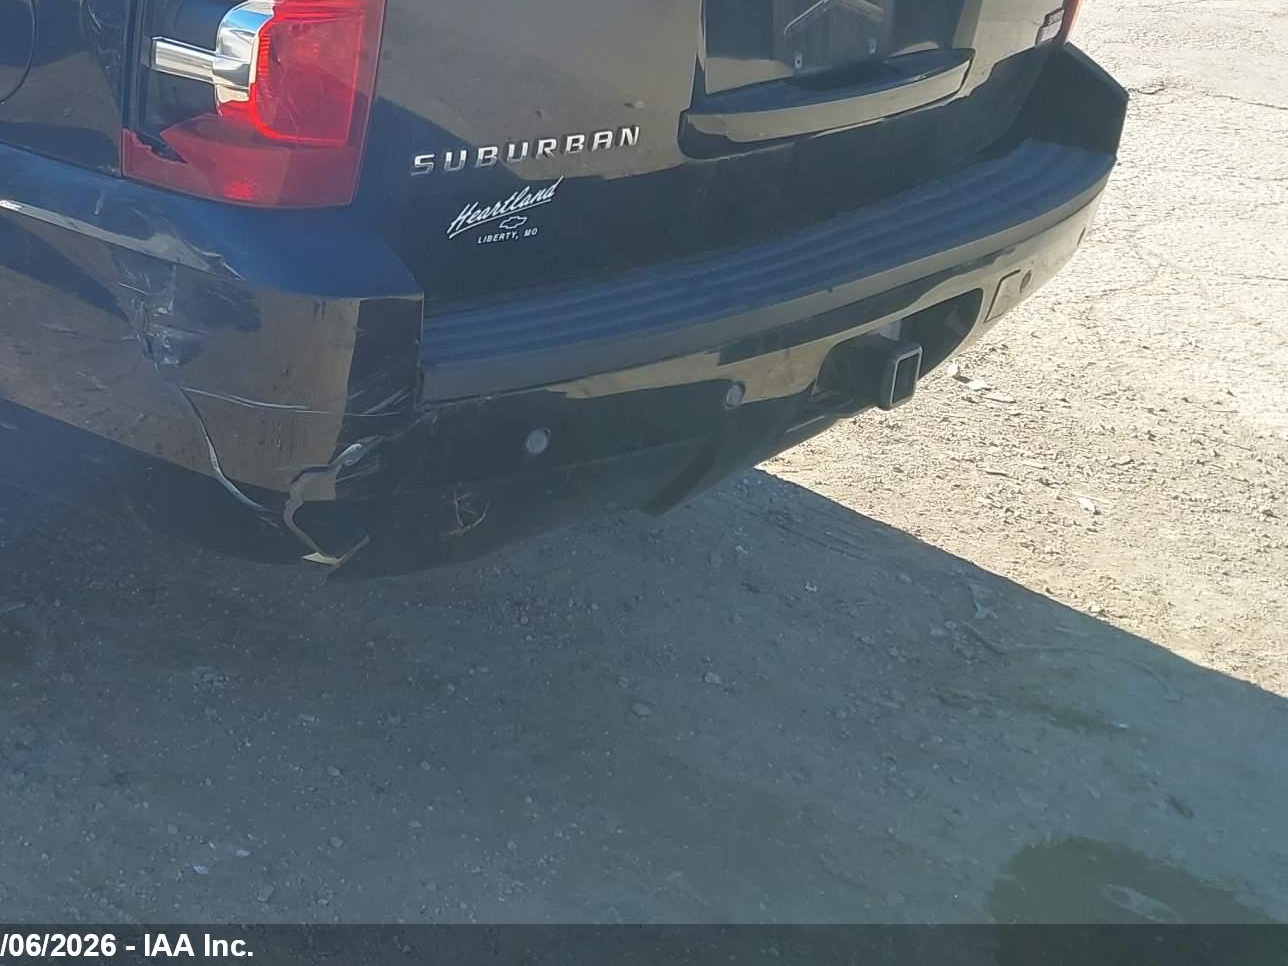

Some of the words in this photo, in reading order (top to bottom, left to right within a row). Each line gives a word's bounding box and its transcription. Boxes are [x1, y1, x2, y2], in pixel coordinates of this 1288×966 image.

[411, 125, 641, 177] SUBURBAN
[446, 175, 564, 237] Heartland
[477, 230, 520, 245] LIBERTY,
[523, 227, 539, 239] MO
